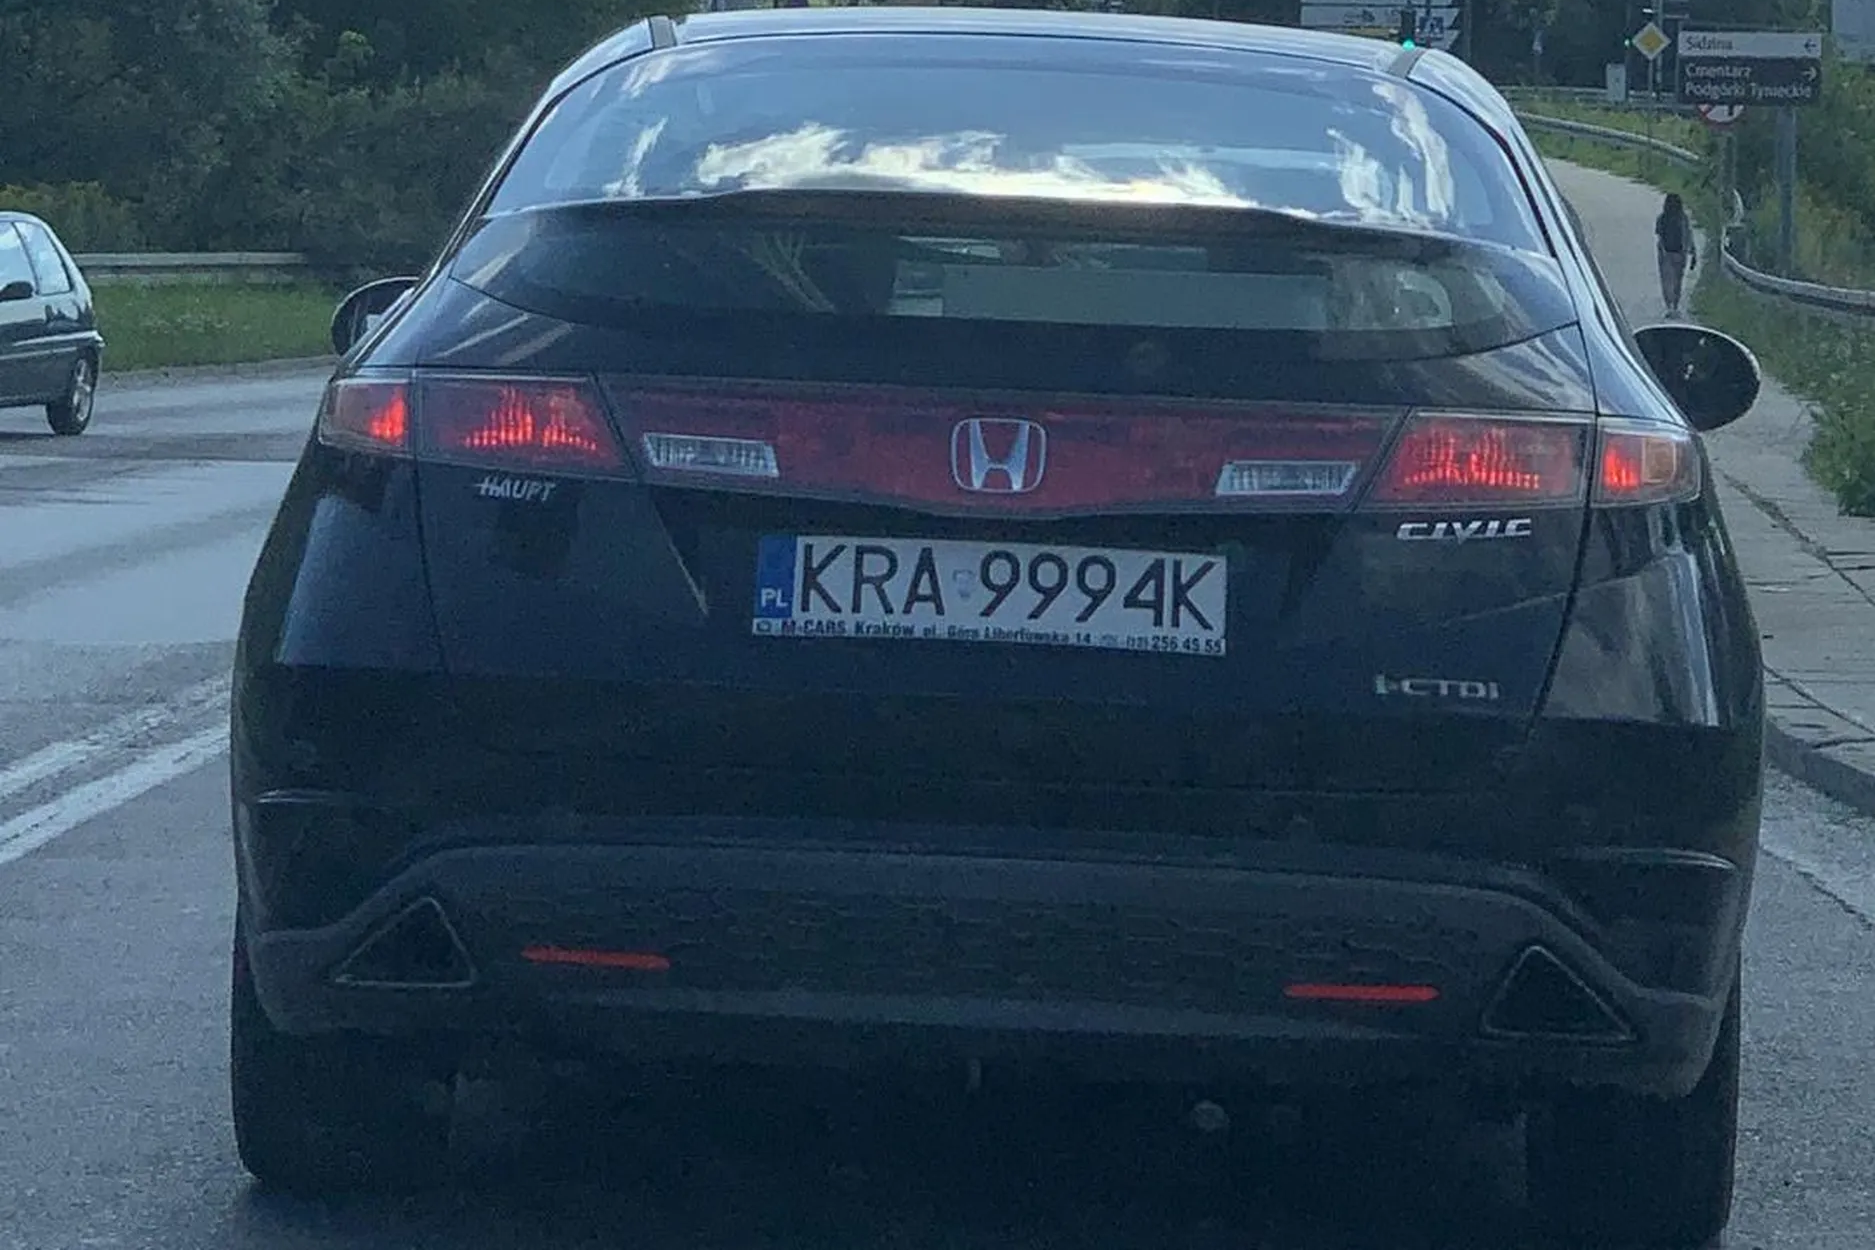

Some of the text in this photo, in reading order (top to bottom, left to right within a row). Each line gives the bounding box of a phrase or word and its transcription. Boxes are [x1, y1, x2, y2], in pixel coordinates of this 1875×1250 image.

[1685, 63, 1751, 78] Cmentarz
[1397, 518, 1532, 544] CIVIC
[761, 588, 789, 608] PL
[801, 543, 1216, 631] KRA 9994K
